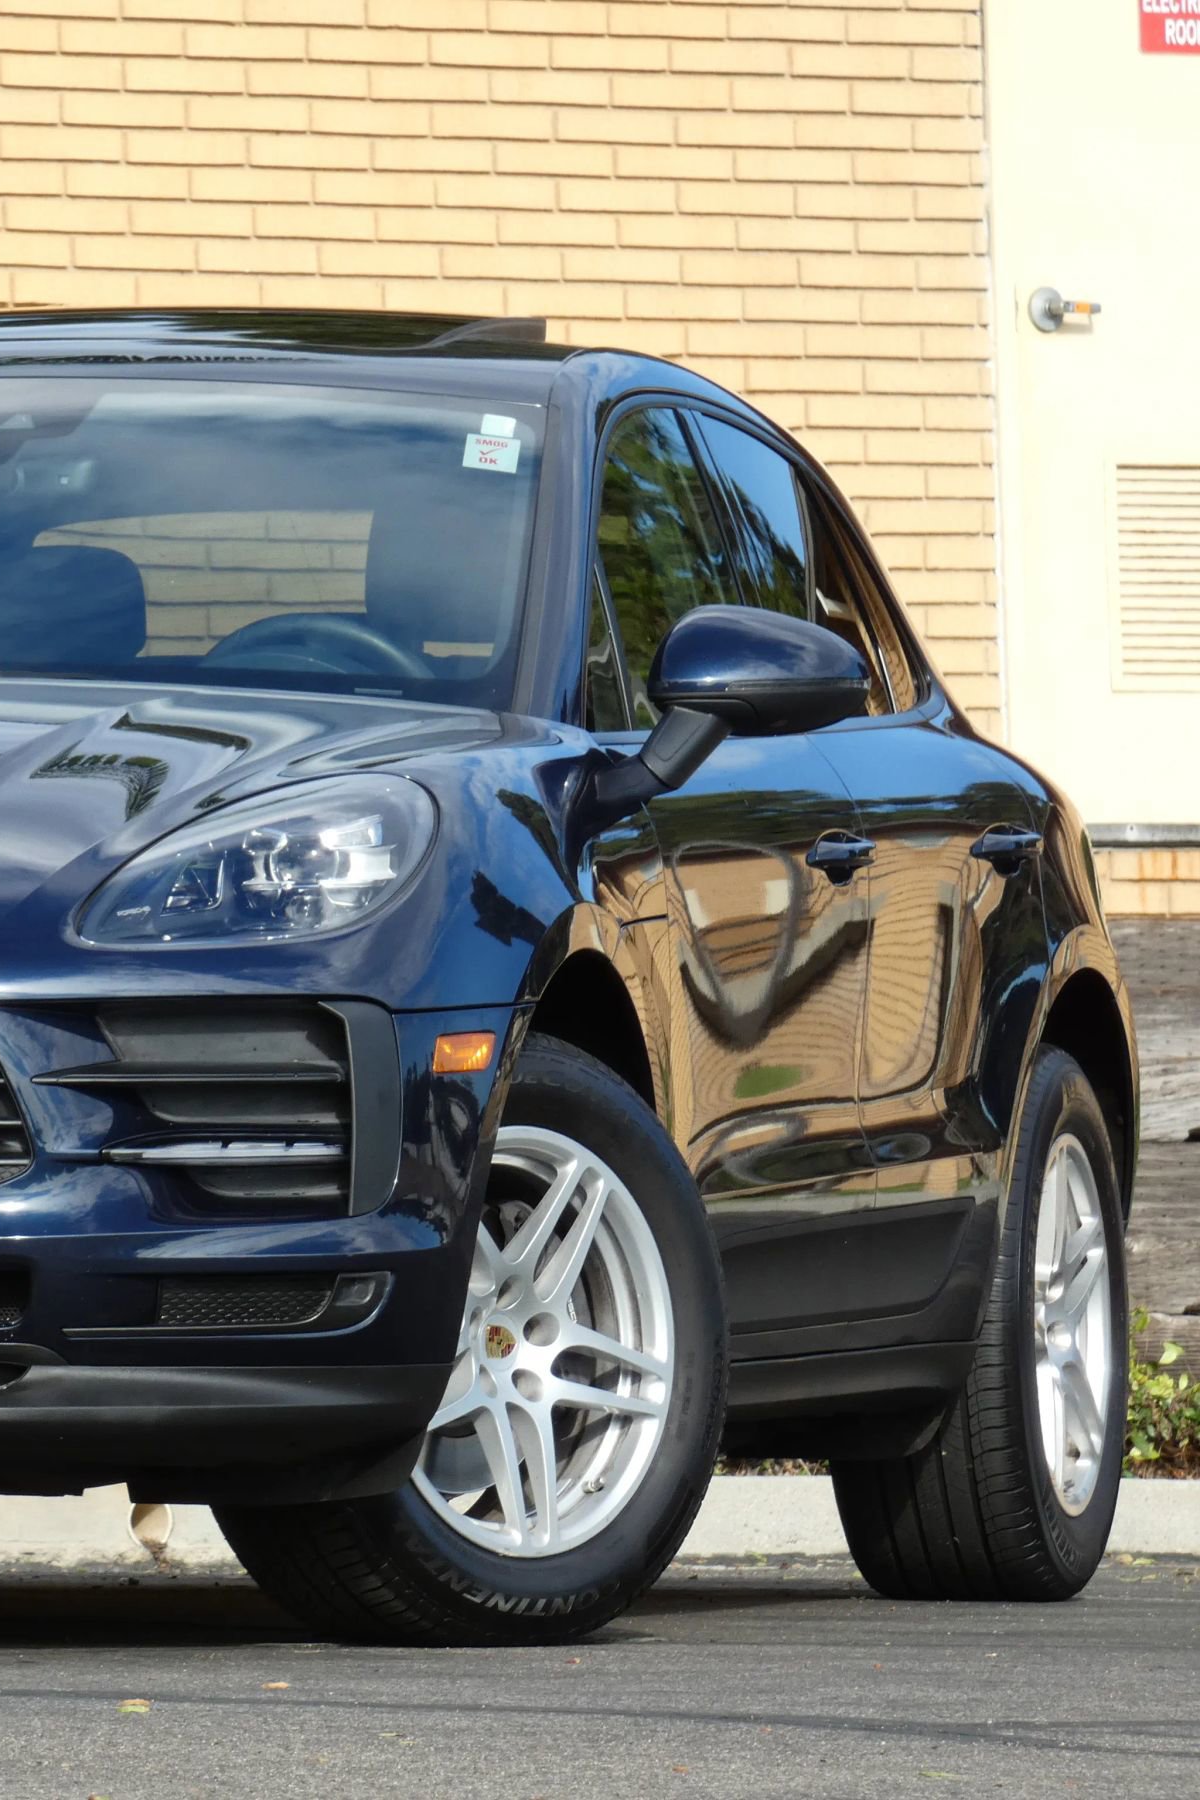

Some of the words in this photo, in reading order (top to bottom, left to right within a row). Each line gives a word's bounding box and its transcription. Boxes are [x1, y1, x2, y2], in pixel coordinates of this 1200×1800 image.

[1141, 0, 1200, 14] ELECTR
[1164, 18, 1200, 46] ROO
[474, 437, 509, 449] SMOG
[478, 456, 499, 465] OK
